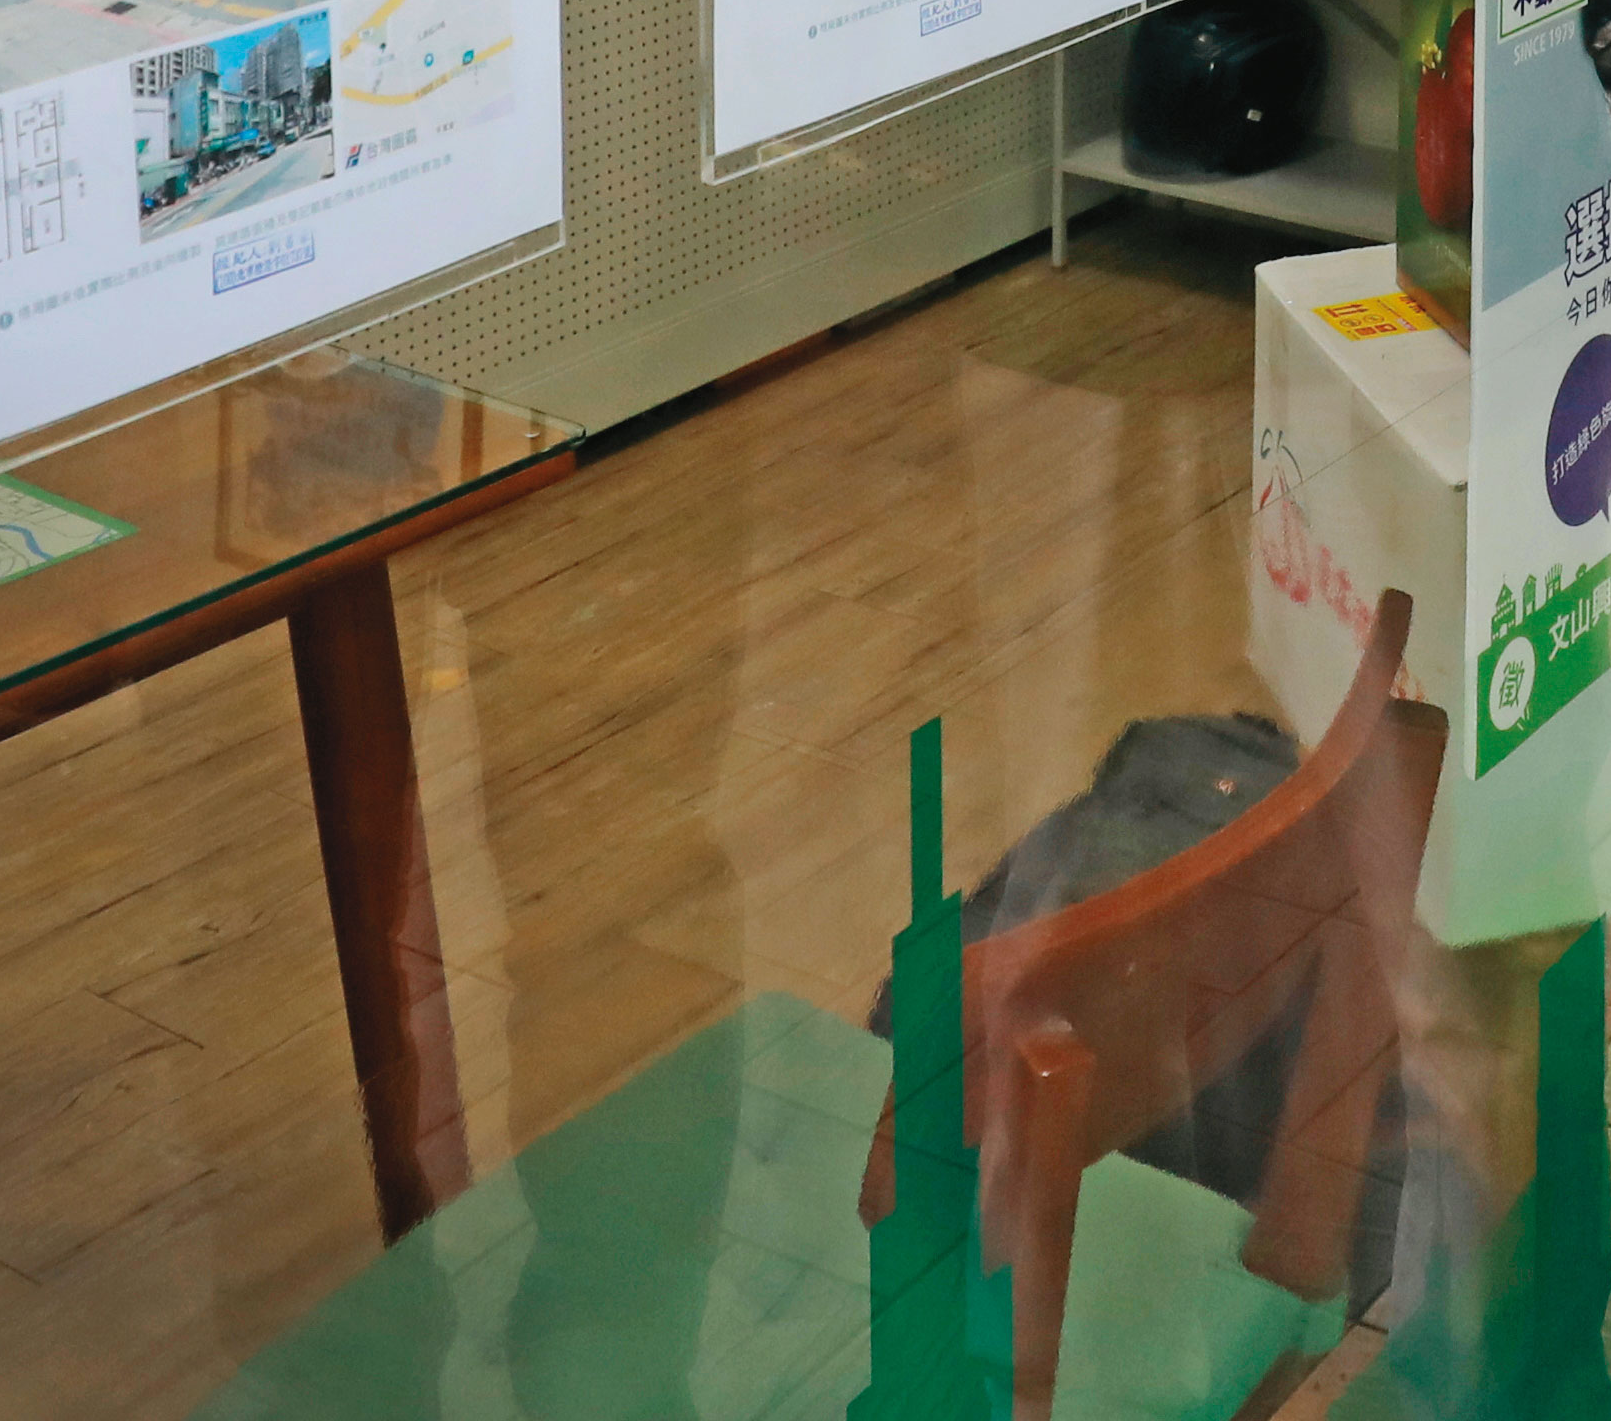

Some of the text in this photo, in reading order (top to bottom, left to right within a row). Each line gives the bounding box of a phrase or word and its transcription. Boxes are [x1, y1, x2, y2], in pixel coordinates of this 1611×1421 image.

[1513, 20, 1576, 64] SINCE 1979
[1499, 660, 1523, 710] 徵
